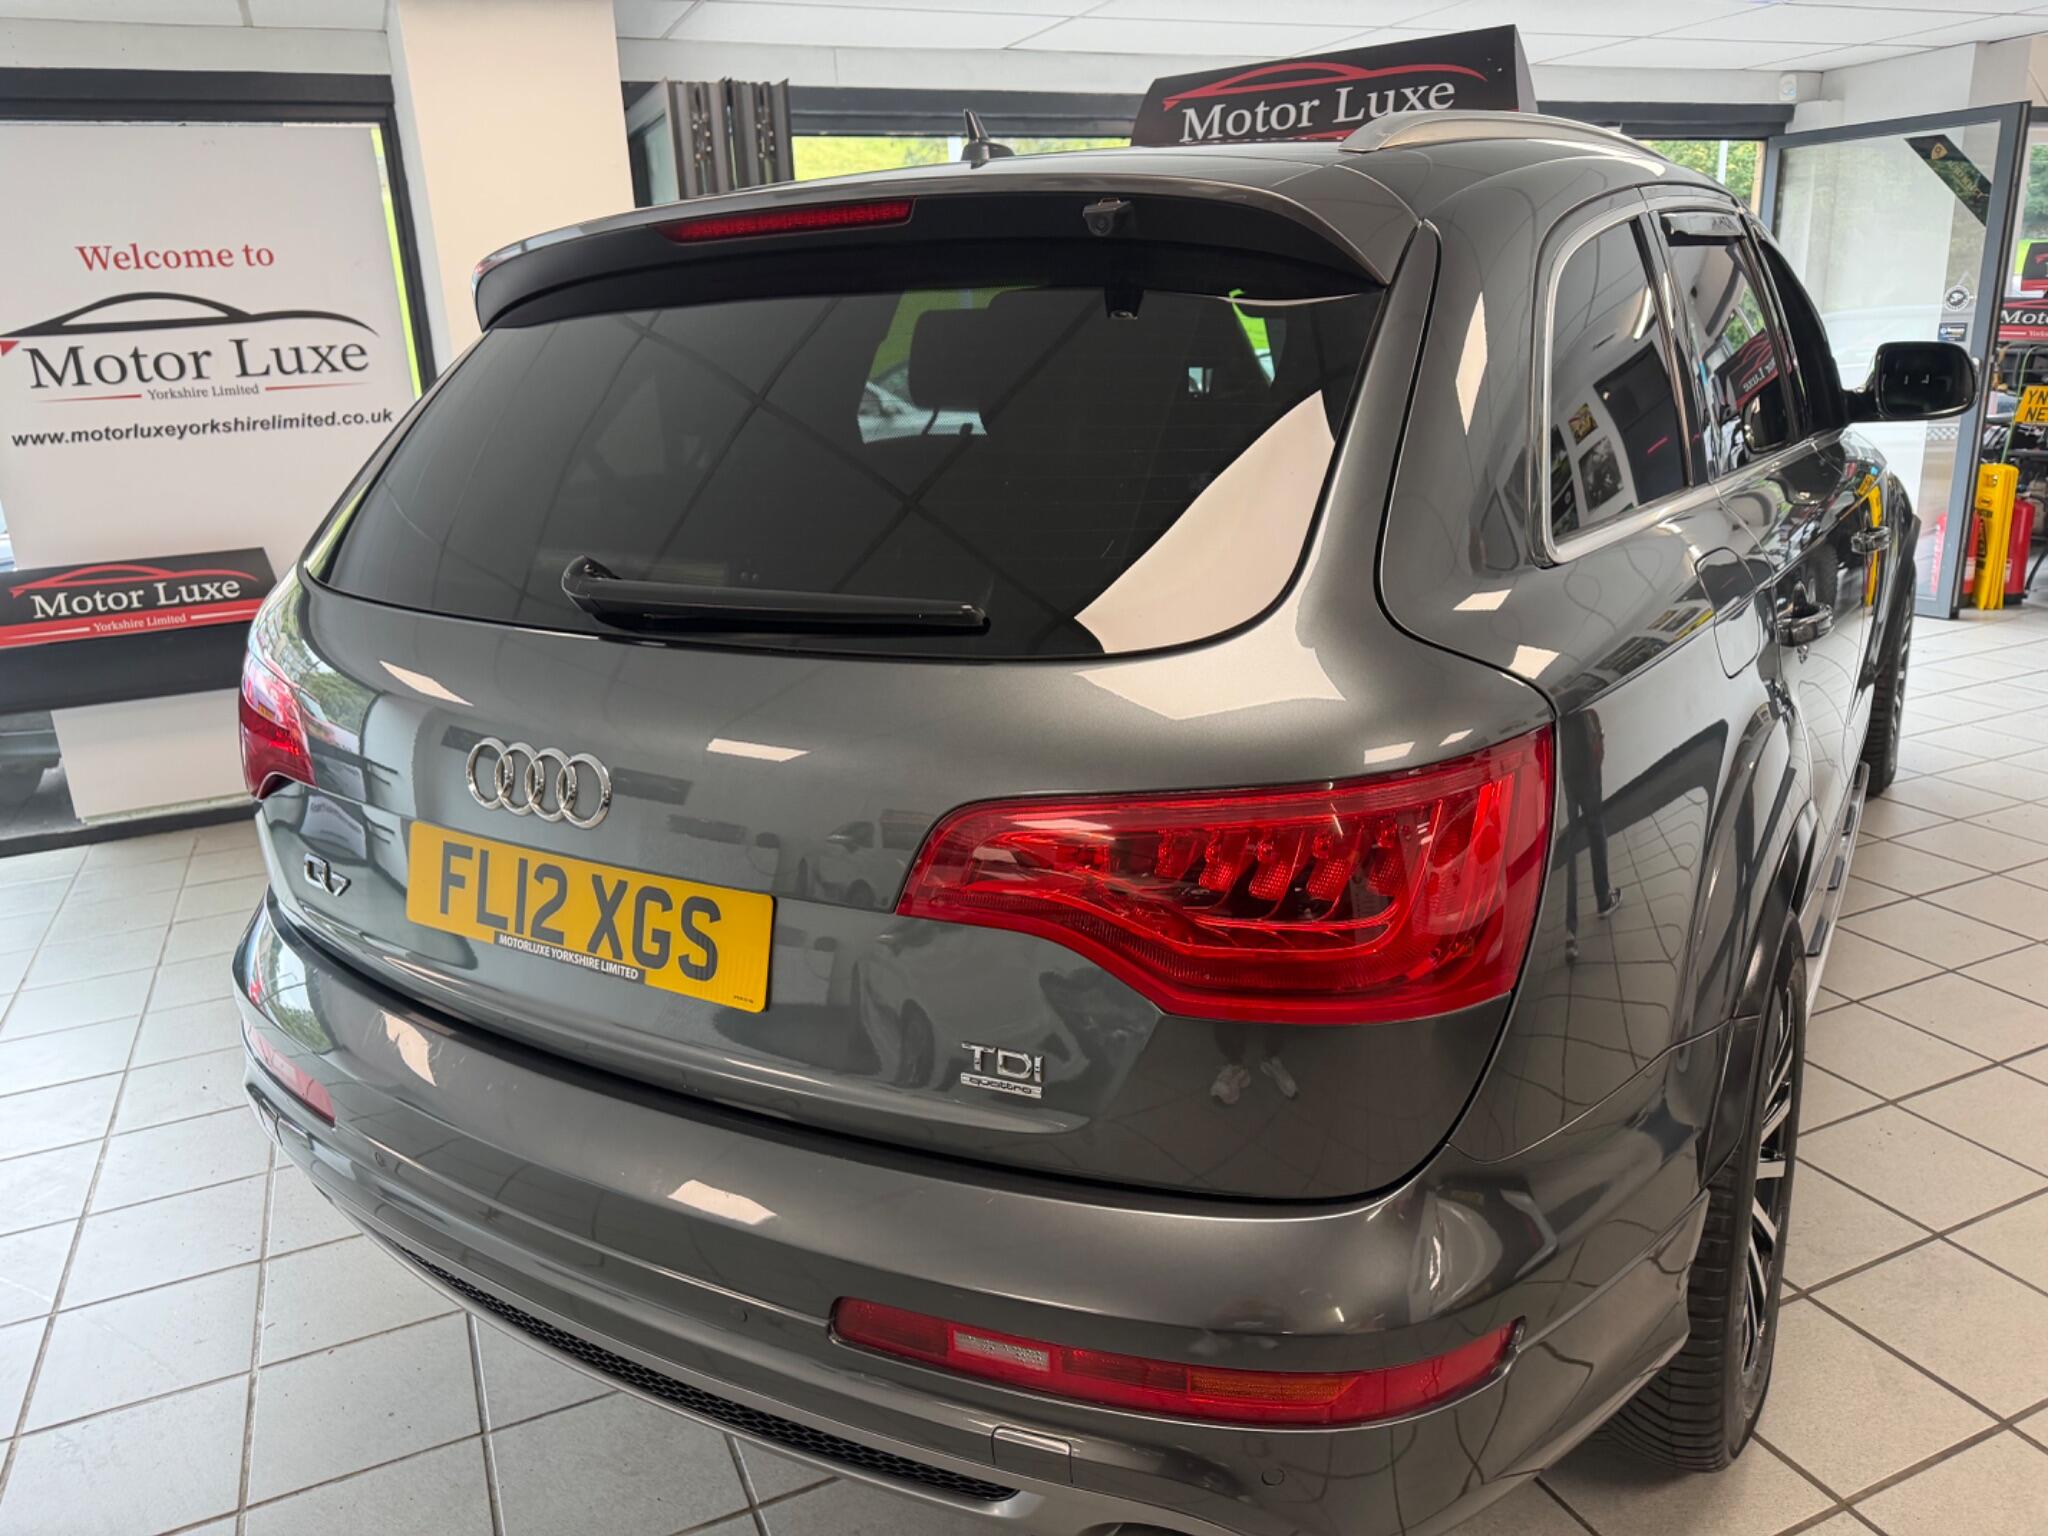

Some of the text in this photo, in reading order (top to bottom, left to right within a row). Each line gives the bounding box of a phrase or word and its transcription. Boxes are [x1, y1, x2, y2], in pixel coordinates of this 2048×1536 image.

[1179, 81, 1456, 142] Motor Luxe
[76, 243, 275, 271] Welcome to
[2000, 309, 2048, 325] Mot
[23, 338, 370, 388] Motor Luxe
[146, 383, 260, 401] Yorkshire Limited
[11, 408, 394, 447] www.motorluxeyorkshirelimited.co.uk
[30, 580, 241, 619] Motor Luxe
[93, 613, 187, 632] Yorkshire Limited
[439, 840, 722, 982] FL12 XGS
[499, 934, 639, 980] MOTORLUXE YORKSHIRE LIMITED
[961, 1042, 1043, 1083] TDI
